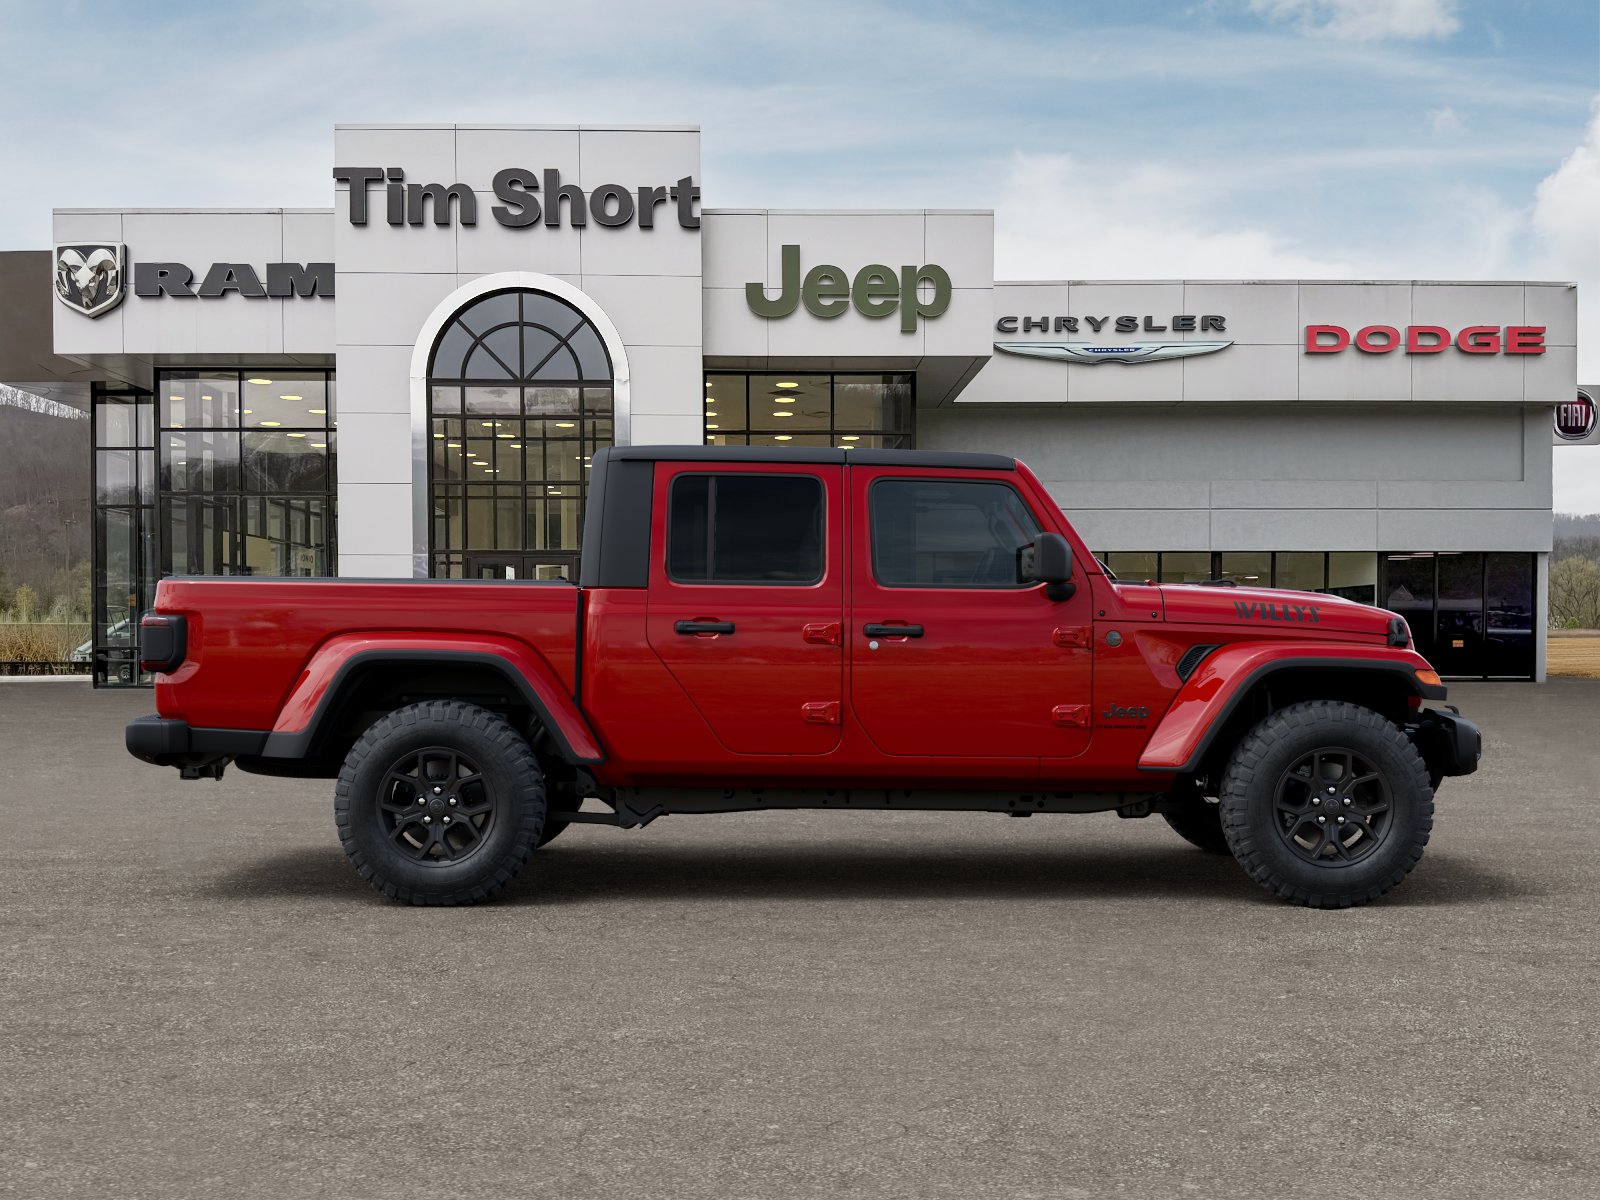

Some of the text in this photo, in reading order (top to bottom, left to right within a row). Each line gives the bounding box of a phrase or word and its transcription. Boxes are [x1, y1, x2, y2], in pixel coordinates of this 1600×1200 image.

[333, 167, 700, 229] Tim Short
[134, 262, 335, 299] RAM
[745, 244, 952, 333] Jeep
[996, 315, 1227, 333] CHRYSLER
[1304, 324, 1547, 354] DODGE
[1560, 403, 1586, 427] FIAT
[1233, 601, 1320, 623] WILLYS
[1103, 703, 1150, 721] Jeep
